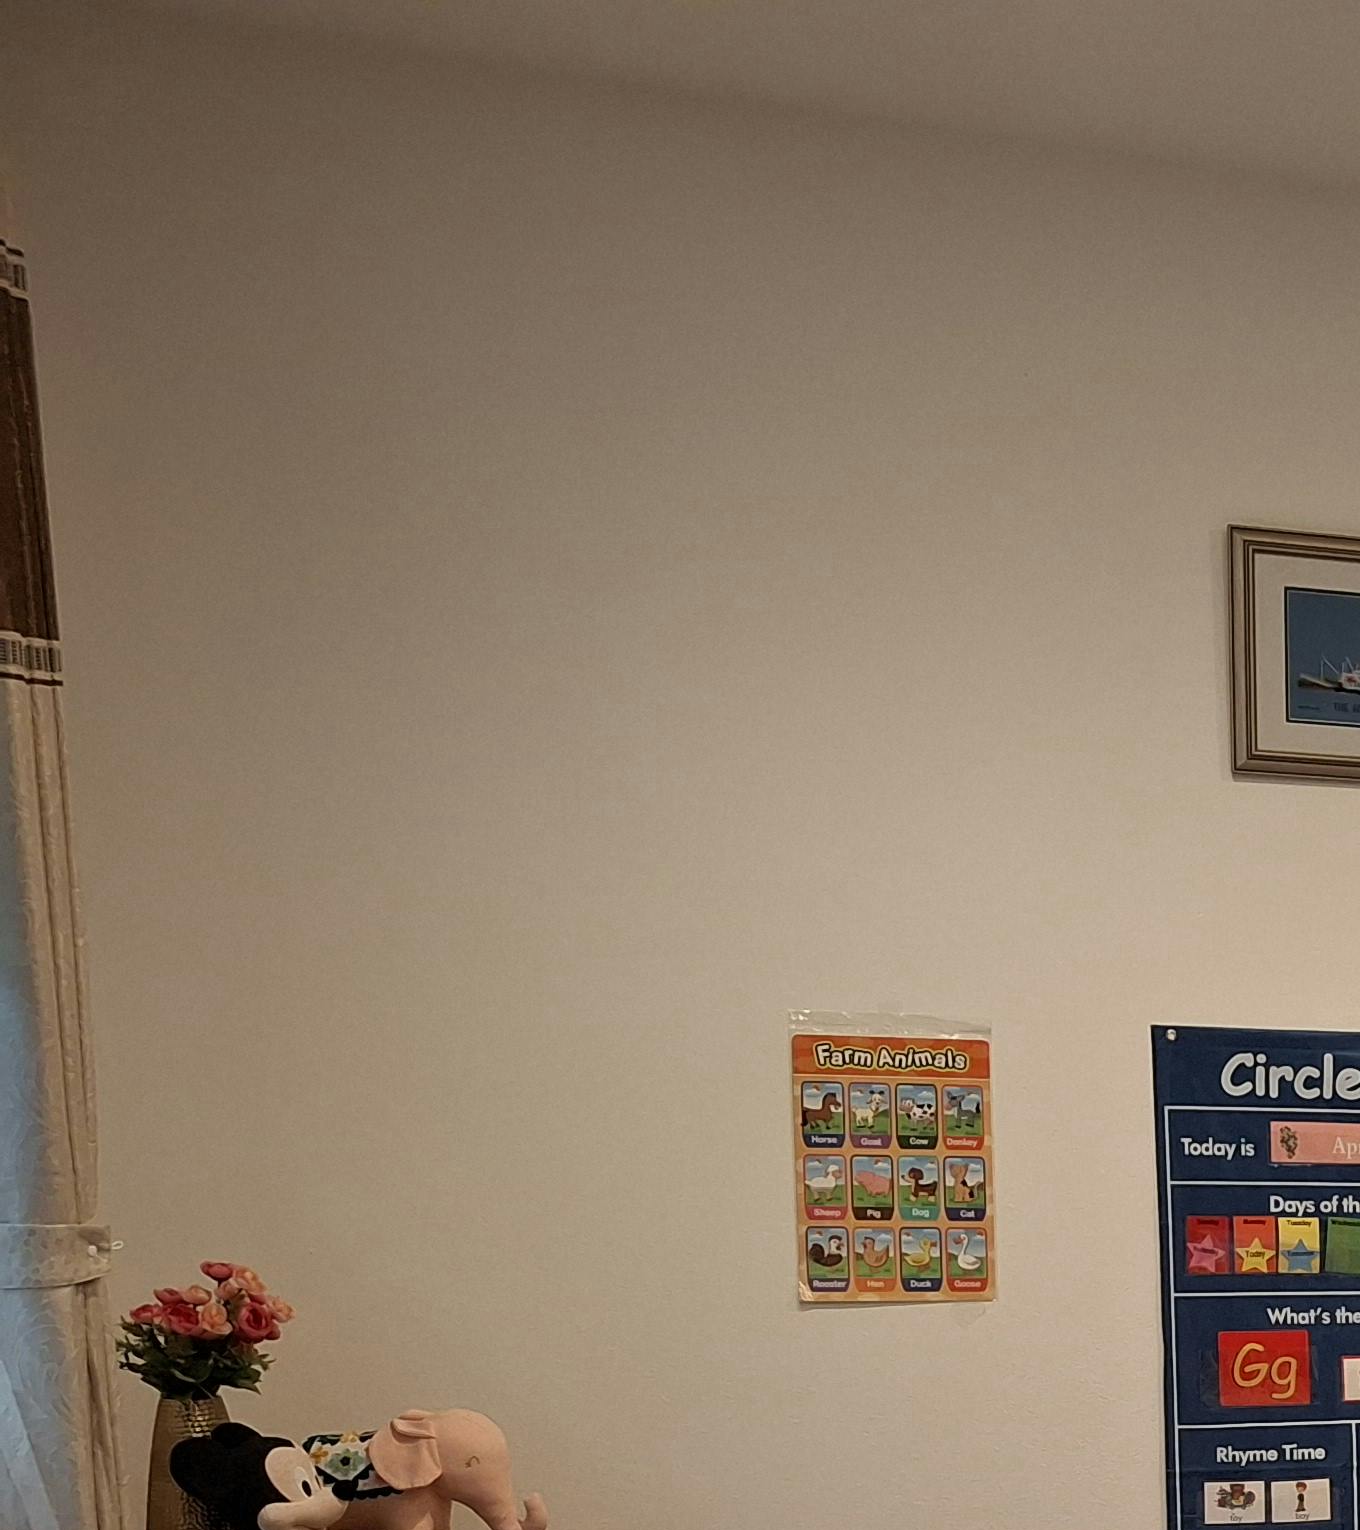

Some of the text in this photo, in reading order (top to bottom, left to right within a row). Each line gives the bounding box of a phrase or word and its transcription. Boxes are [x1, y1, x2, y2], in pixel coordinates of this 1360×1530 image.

[814, 1043, 967, 1070] Farm Animals
[910, 1137, 929, 1146] Cow
[1180, 1138, 1236, 1161] Today
[1241, 1138, 1255, 1156] is
[867, 1209, 881, 1219] Pig
[912, 1208, 930, 1218] Dog
[960, 1209, 975, 1218] Cat
[1269, 1195, 1315, 1216] Days
[1320, 1195, 1339, 1213] of
[1286, 1219, 1312, 1227] Tuesday
[1267, 1306, 1331, 1326] What's
[1232, 1342, 1298, 1400] Gg
[1216, 1444, 1326, 1466] Rhyme Time
[1229, 1510, 1310, 1523] toy boy
